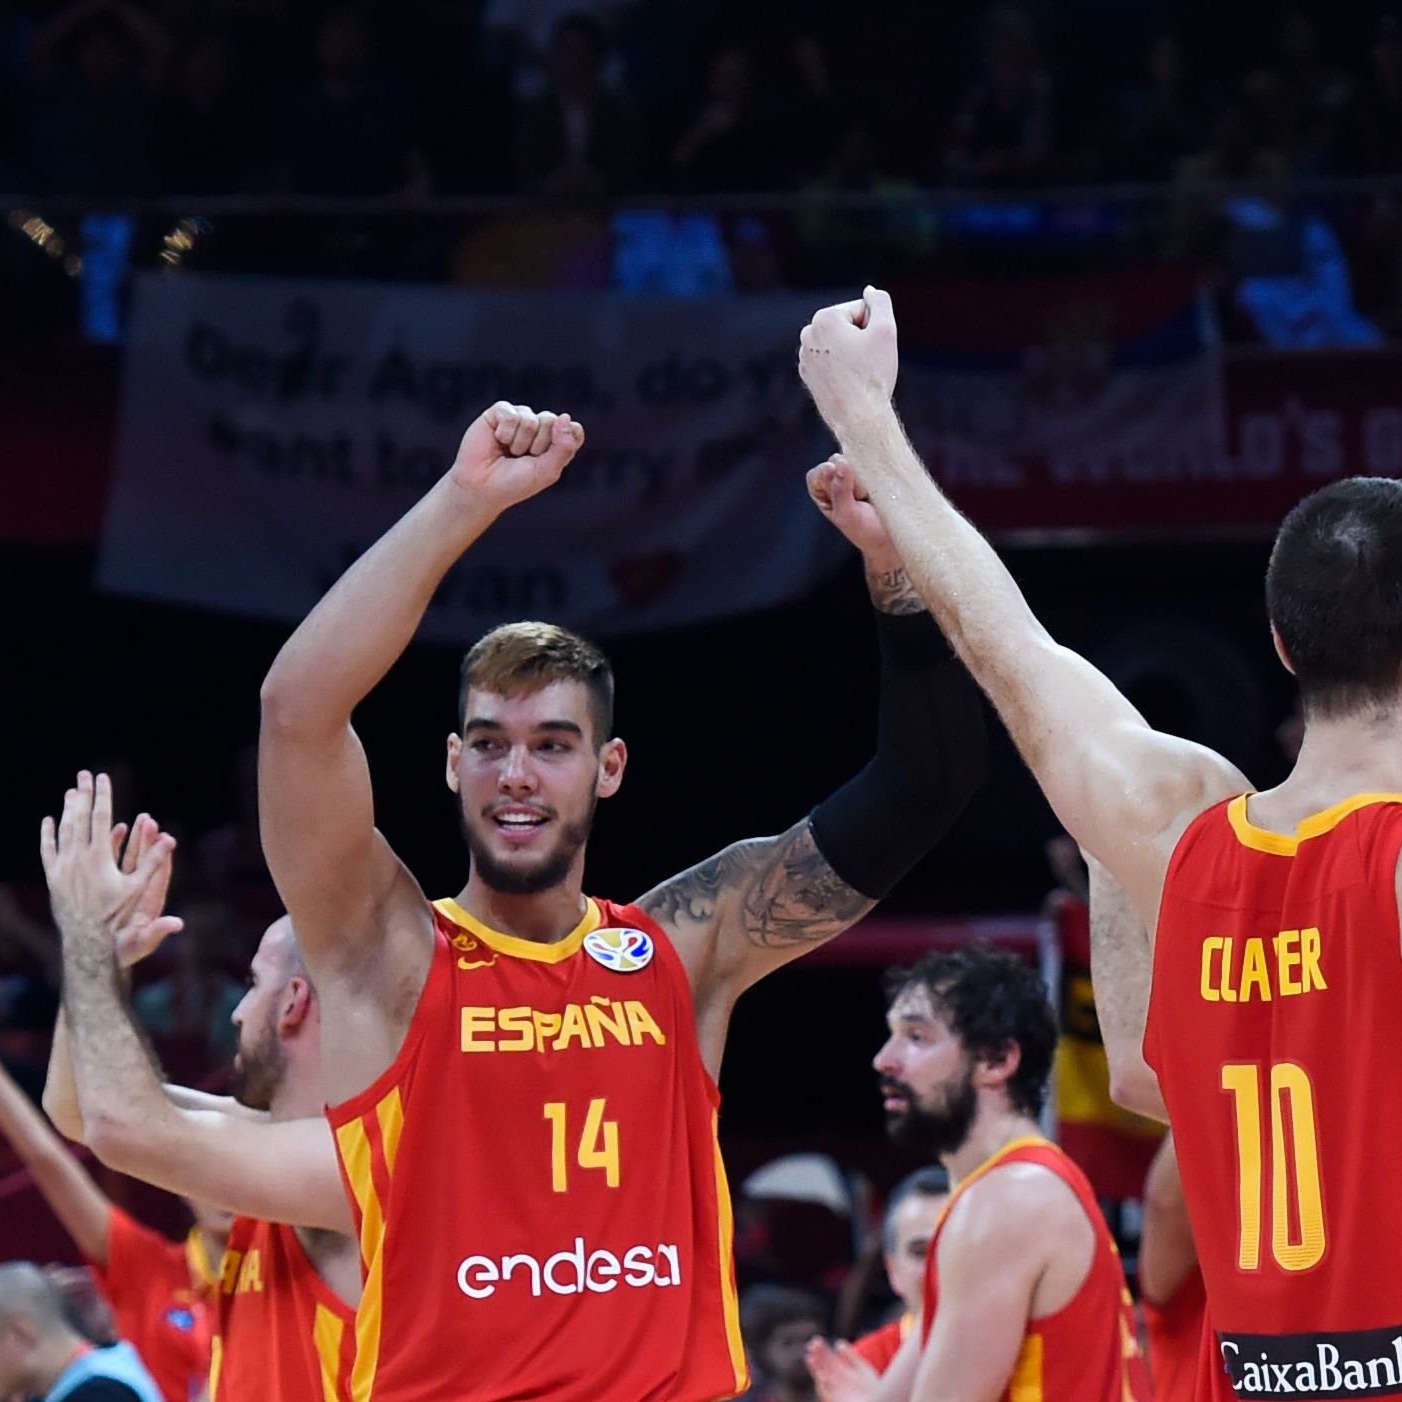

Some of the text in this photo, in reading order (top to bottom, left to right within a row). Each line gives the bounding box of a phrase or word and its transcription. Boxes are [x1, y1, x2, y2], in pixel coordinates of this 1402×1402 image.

[1201, 927, 1328, 1003] CLAER
[460, 996, 666, 1053] ESPAÑA
[543, 1098, 621, 1193] 14
[1221, 1062, 1327, 1272] 10
[457, 1237, 681, 1299] endesa
